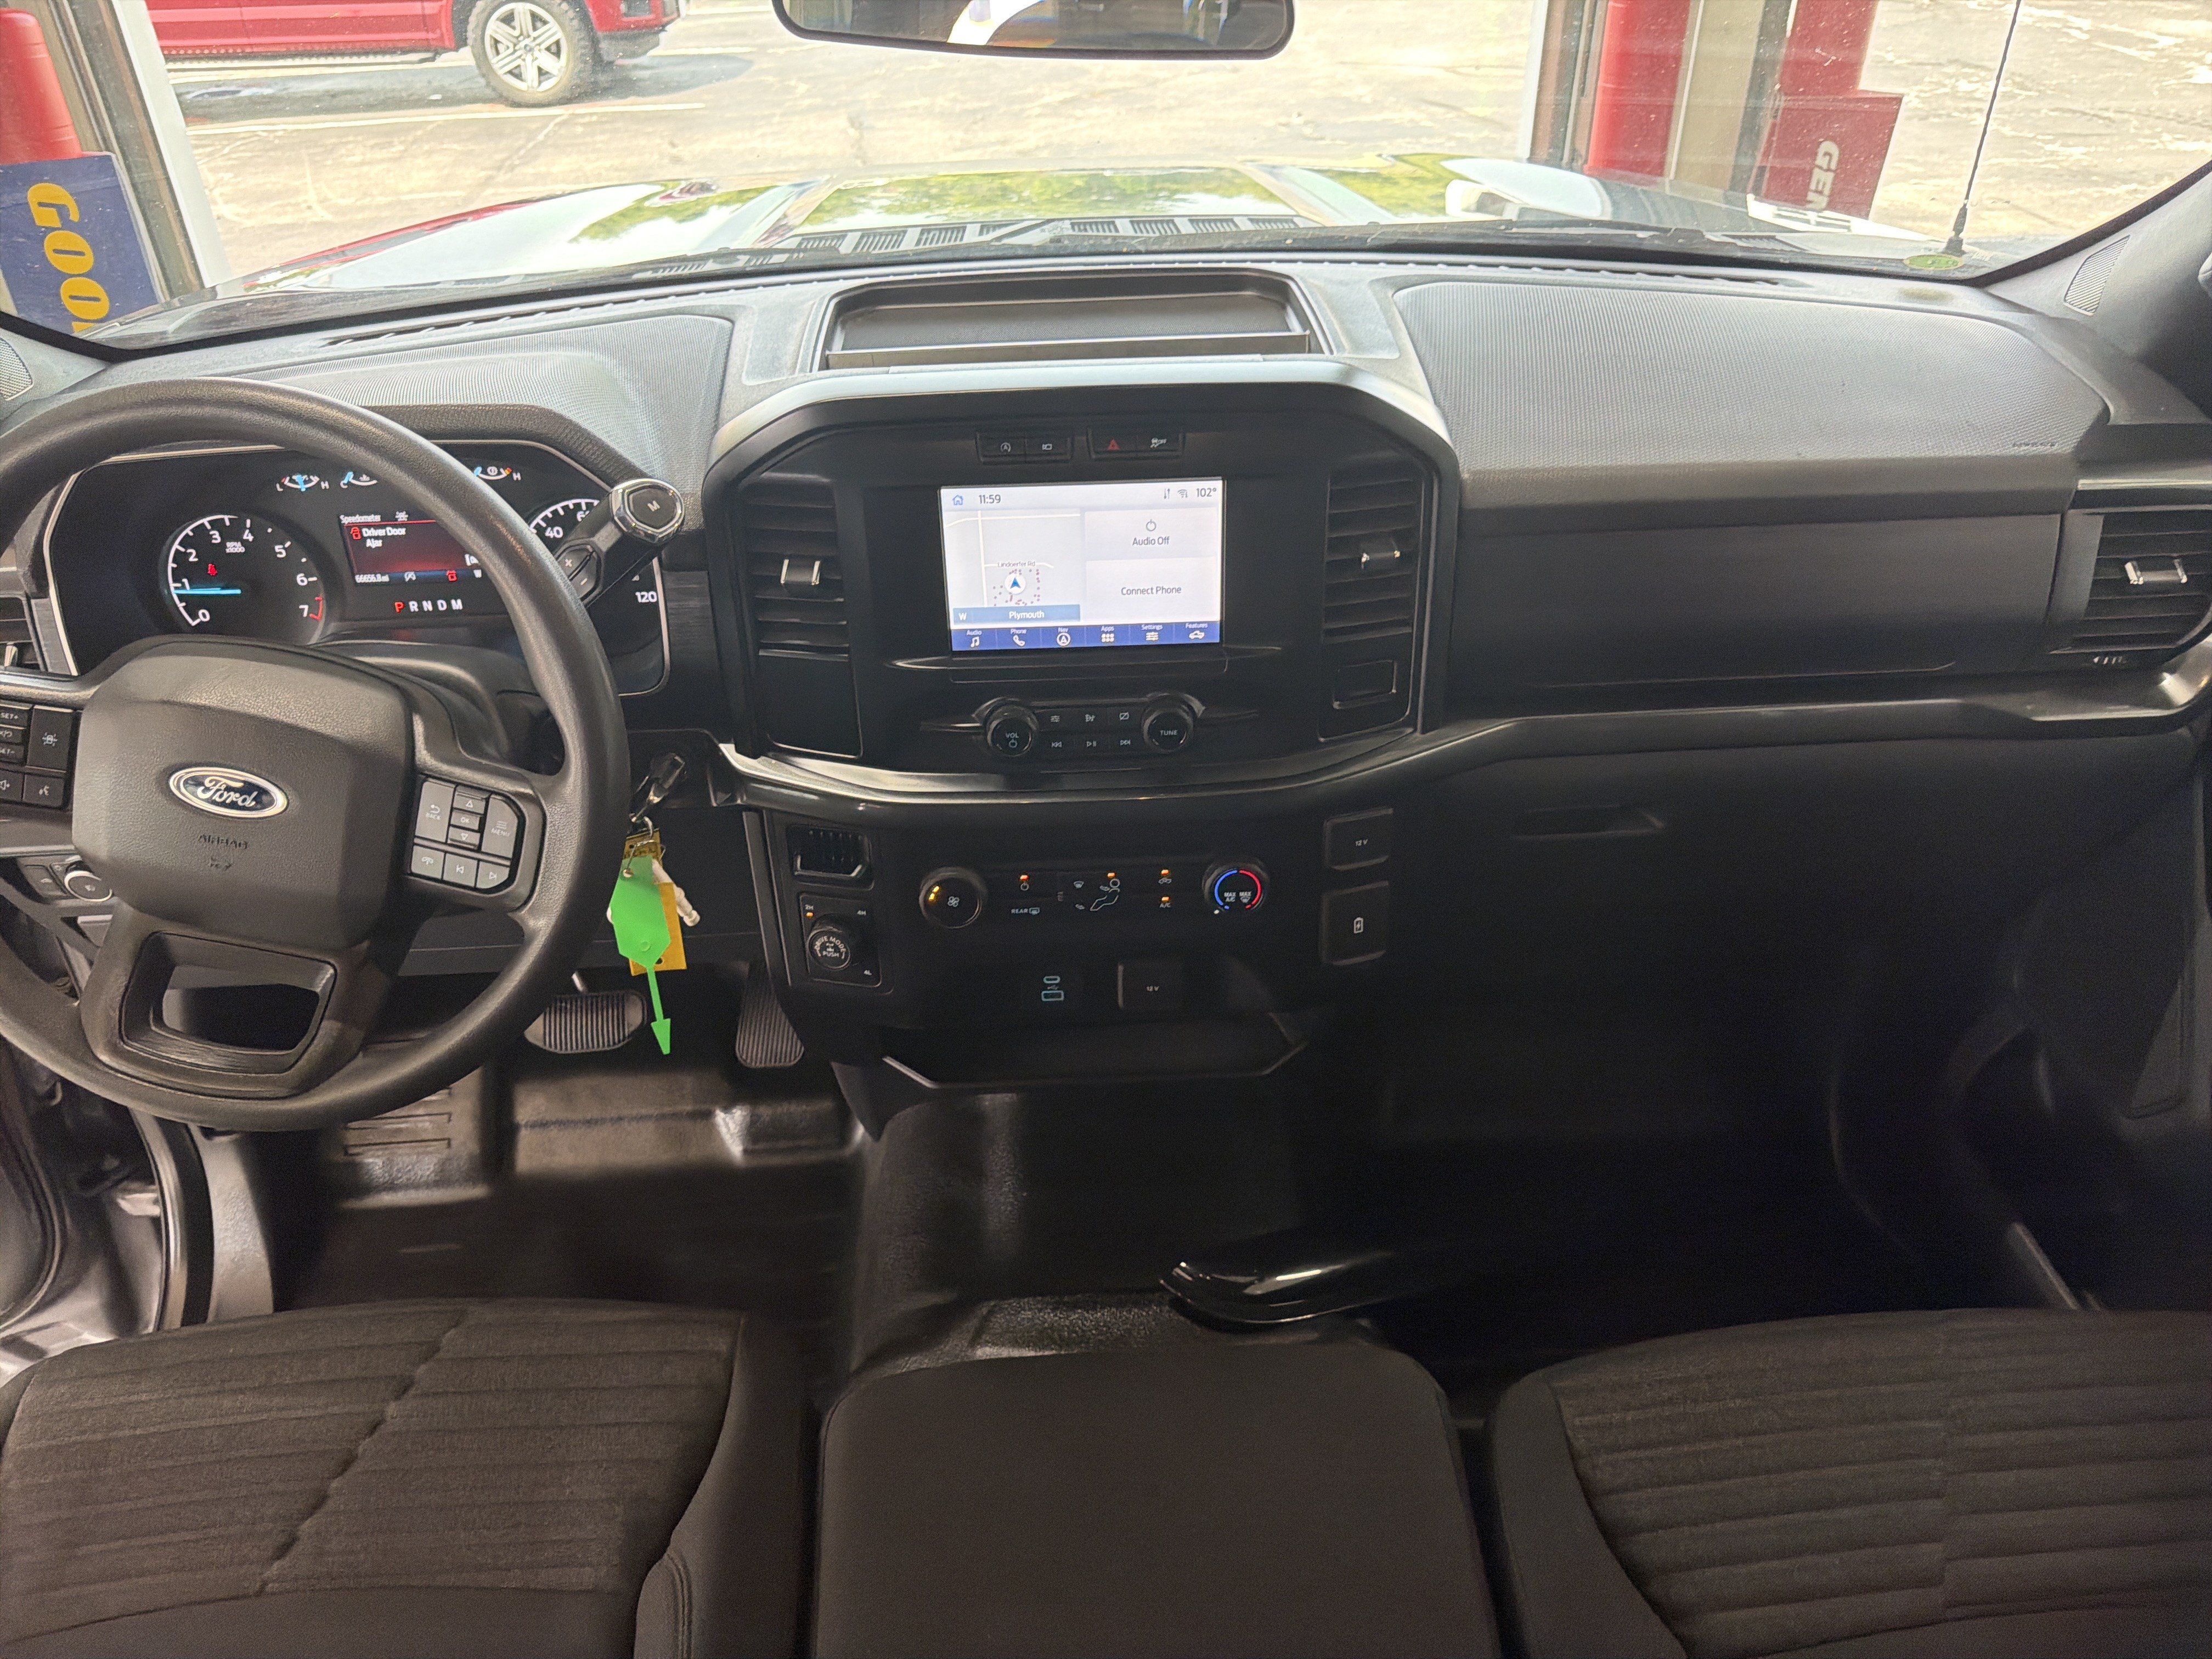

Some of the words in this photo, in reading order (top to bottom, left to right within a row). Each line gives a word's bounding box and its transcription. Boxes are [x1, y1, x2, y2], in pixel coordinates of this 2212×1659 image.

[27, 183, 110, 332] GOO
[513, 472, 521, 481] H
[321, 481, 329, 489] H
[979, 494, 1001, 504] 11:59
[340, 514, 381, 524] Speedometer
[210, 530, 221, 543] 3
[243, 529, 254, 542] 4
[362, 528, 386, 537] Driver
[386, 527, 407, 536] Door
[545, 526, 564, 539] 40
[366, 538, 383, 549] Ajar
[1132, 537, 1156, 546] Audio
[1157, 536, 1170, 545] Off
[186, 549, 199, 562] 2
[275, 545, 286, 558] 5
[182, 578, 190, 590] 1
[297, 573, 308, 586] 6
[635, 591, 657, 603] 120
[1121, 587, 1153, 596] Connect
[1155, 586, 1182, 595] Phone
[299, 605, 309, 617] 7
[394, 601, 405, 613] P
[409, 601, 419, 612] R
[422, 600, 433, 611] N
[437, 600, 447, 611] D
[451, 599, 463, 610] M
[198, 609, 210, 622] 0
[958, 612, 967, 620] W
[1008, 610, 1045, 620] Plymouth
[197, 776, 258, 808] Ford
